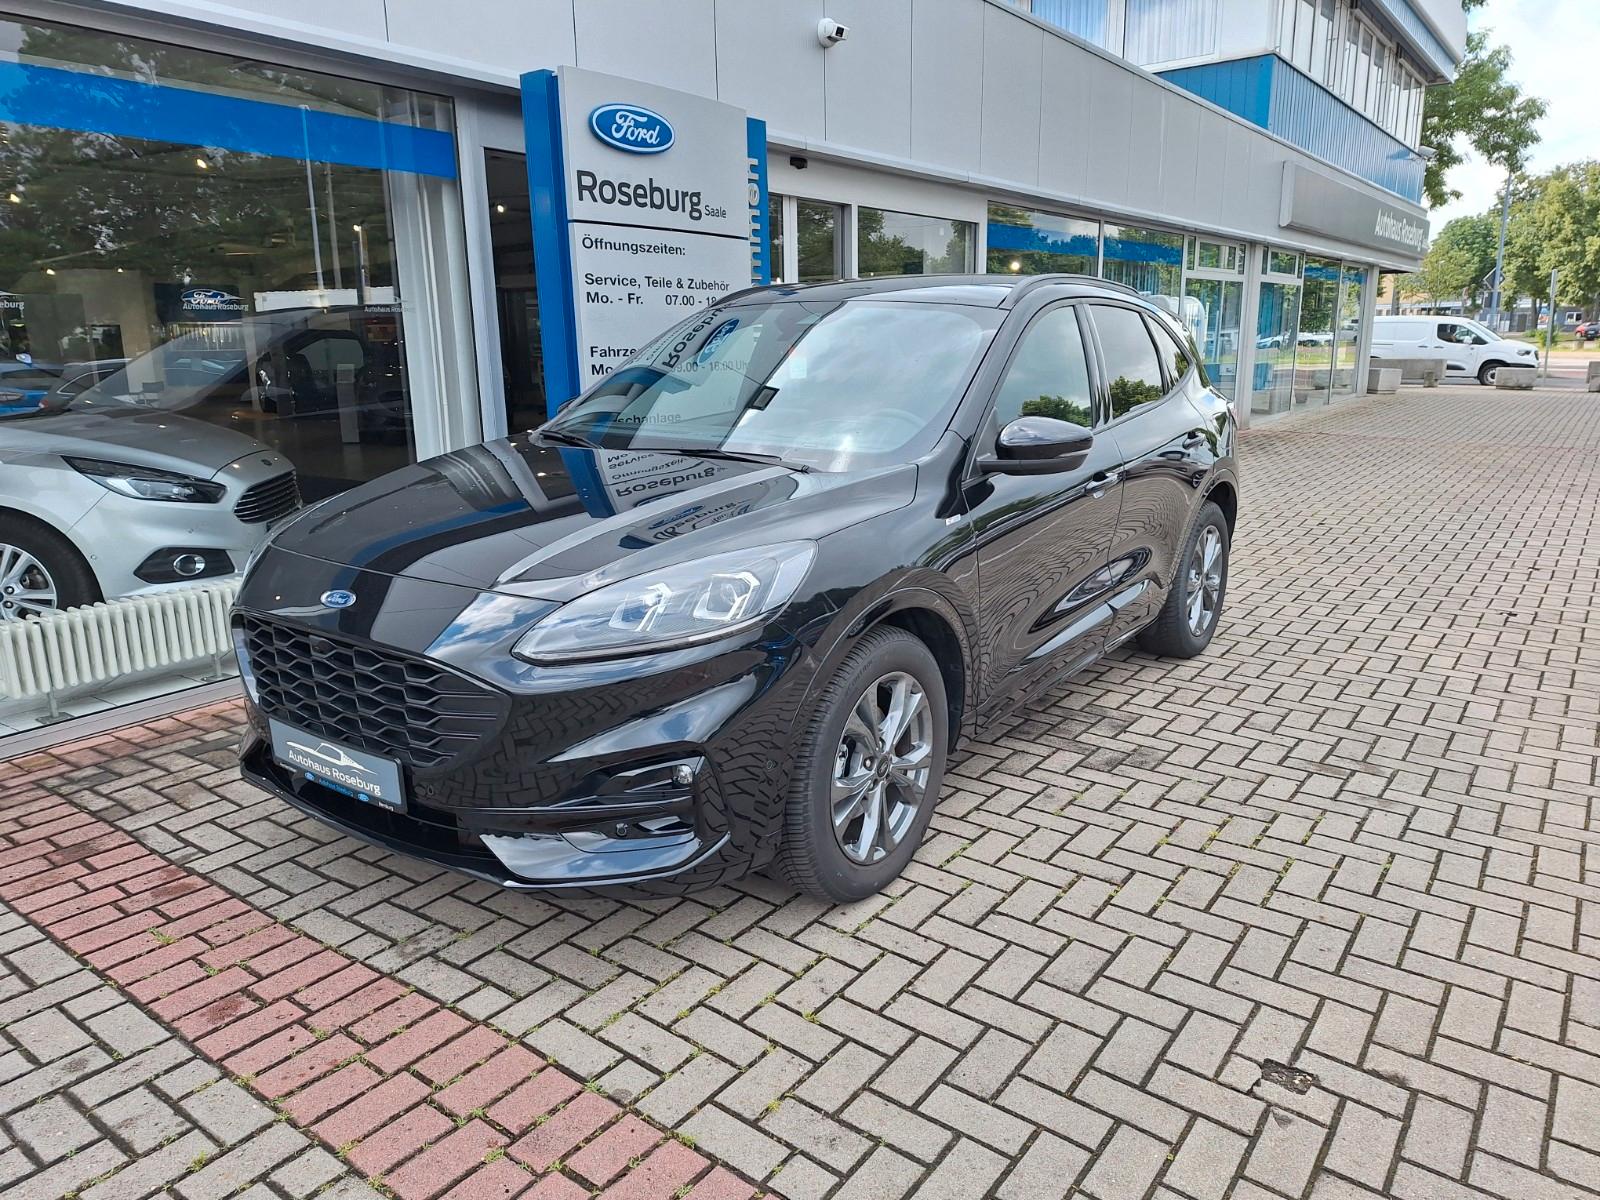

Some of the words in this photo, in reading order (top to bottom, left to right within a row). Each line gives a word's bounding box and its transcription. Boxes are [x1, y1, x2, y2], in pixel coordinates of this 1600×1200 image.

[611, 110, 661, 145] Ford
[576, 169, 703, 221] Roseburg
[704, 204, 727, 219] Saale
[1374, 208, 1402, 241] Autohaus
[582, 233, 686, 256] Öffnungszeiten:
[584, 272, 641, 289] Service,
[644, 275, 673, 289] Teile
[676, 277, 684, 289] &
[687, 278, 730, 292] Zubehör
[182, 303, 217, 311] Autohaus
[217, 303, 249, 312] Roseburg
[190, 291, 221, 305] Ford
[586, 291, 614, 304] Mo.
[627, 292, 644, 305] Fr.
[664, 294, 695, 306] 07.00
[288, 749, 331, 776] Autohaus
[331, 767, 382, 797] Roseburg
